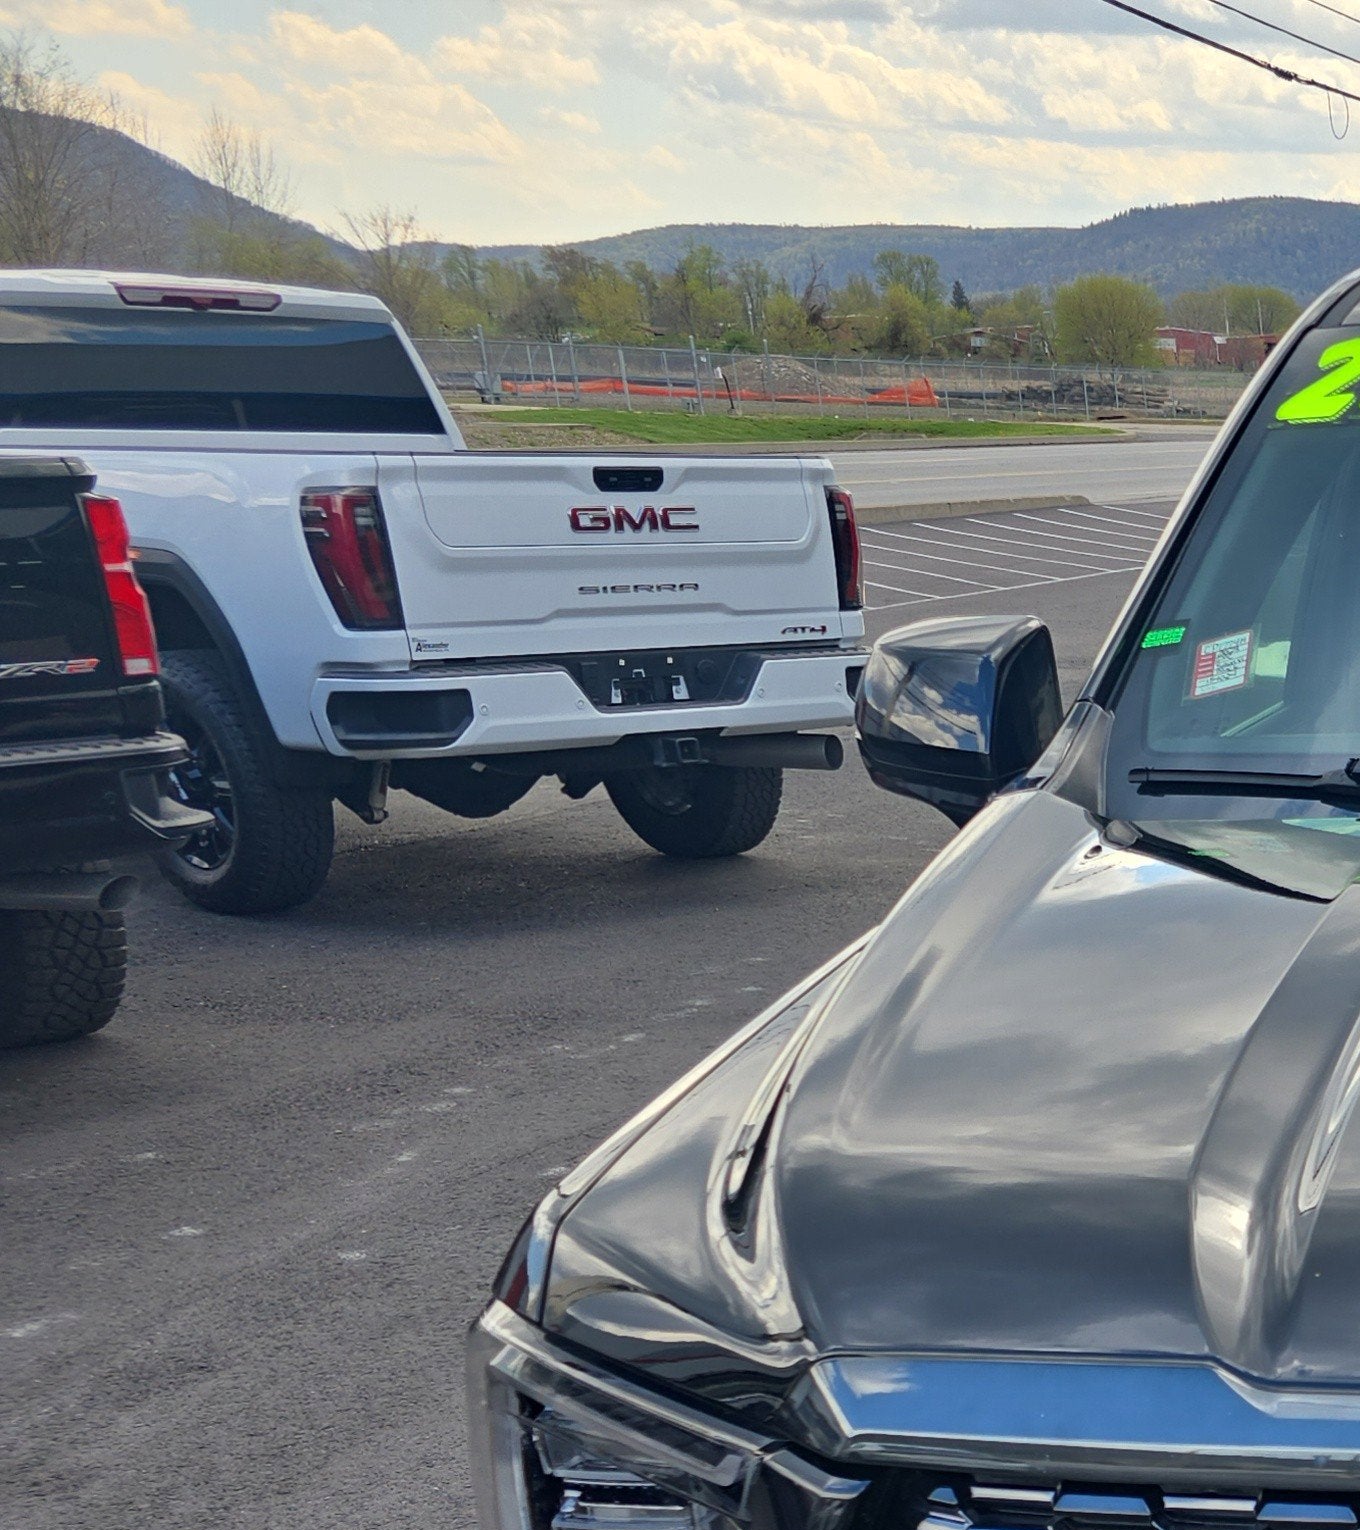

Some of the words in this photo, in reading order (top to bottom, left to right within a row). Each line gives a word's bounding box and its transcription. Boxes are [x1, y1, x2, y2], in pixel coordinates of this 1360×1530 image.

[568, 505, 699, 533] GMC
[578, 582, 699, 595] SIERRA
[781, 624, 827, 635] AT4
